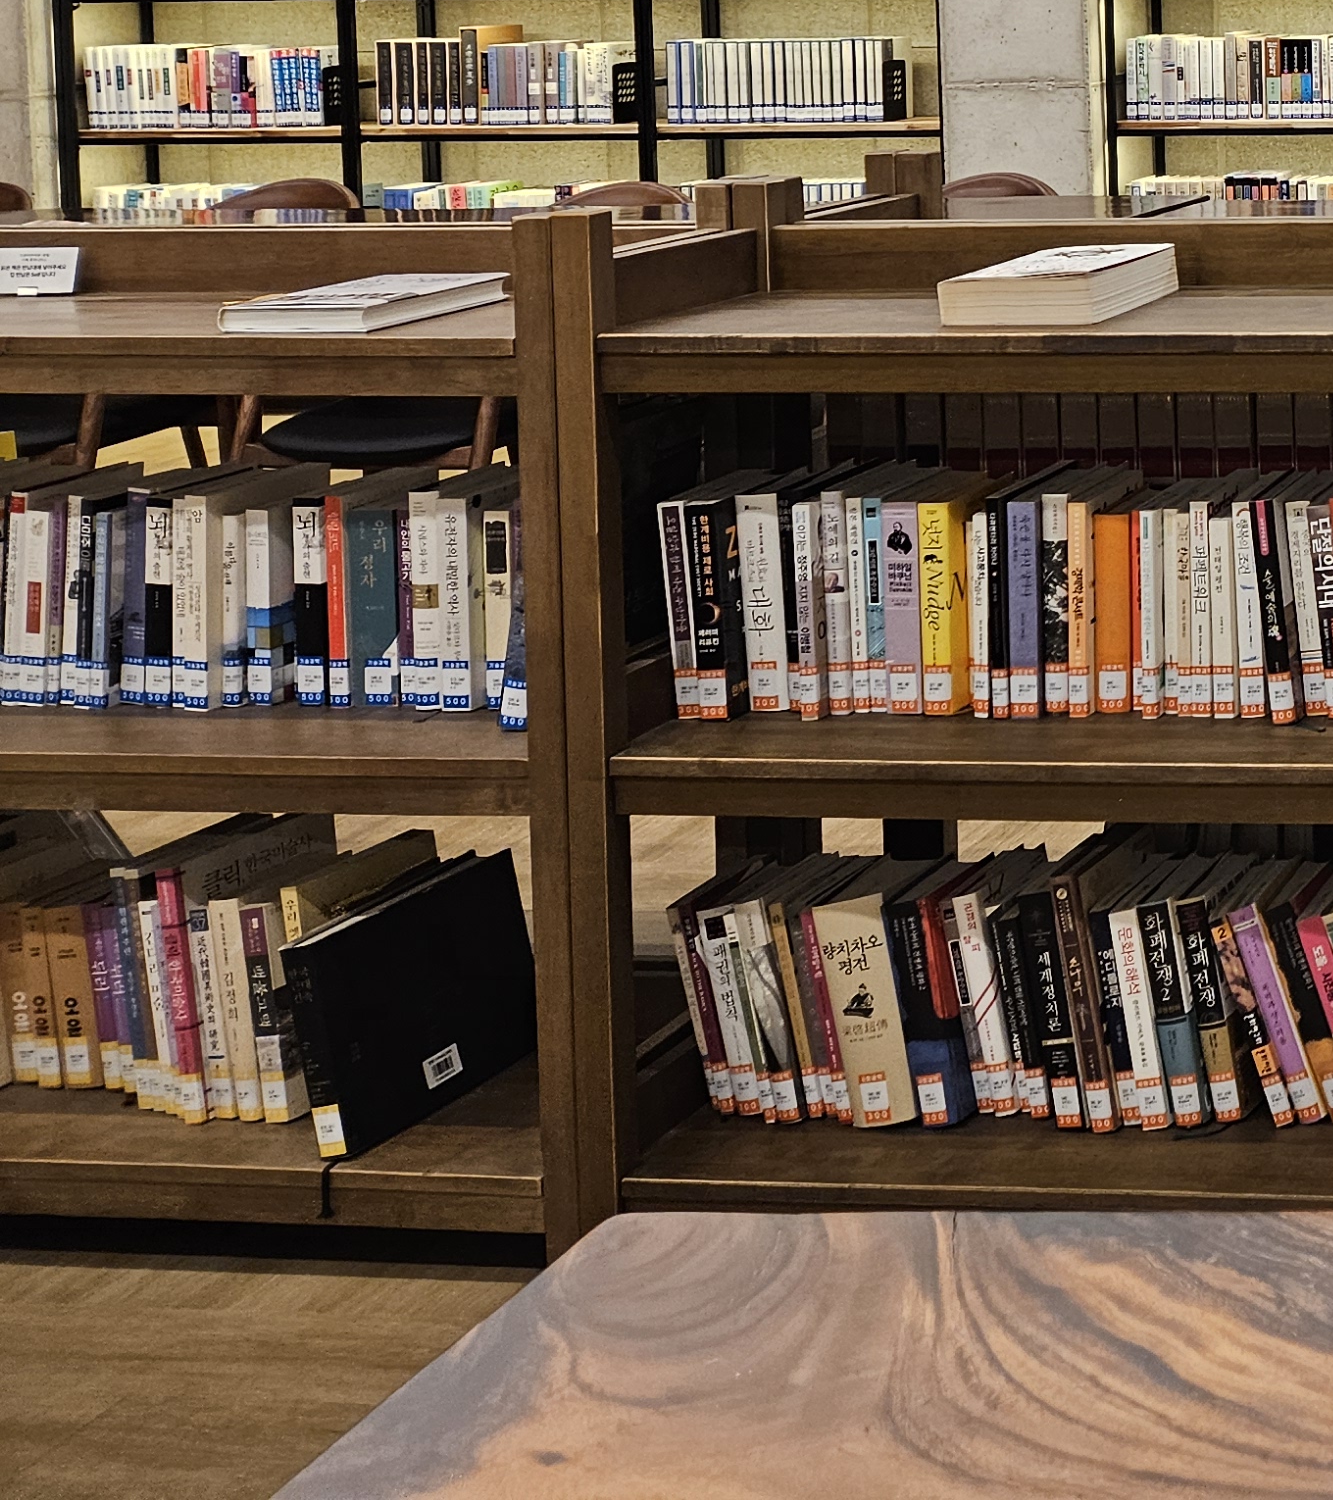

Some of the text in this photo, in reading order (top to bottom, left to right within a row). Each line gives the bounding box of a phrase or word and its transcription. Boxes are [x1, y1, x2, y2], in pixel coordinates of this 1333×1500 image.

[192, 510, 202, 523] 암
[372, 520, 387, 553] 우리
[921, 518, 942, 550] 넛지
[1236, 519, 1251, 575] 행복의 조건
[359, 554, 377, 588] 정자
[797, 555, 808, 581] 정주영
[1192, 546, 1207, 614] 퍼펙트워크
[924, 564, 945, 631] Nudge
[122, 692, 141, 701] 500
[250, 693, 269, 701] 500
[446, 696, 466, 704] 500
[755, 699, 777, 707] 300
[1101, 700, 1123, 708] 300
[823, 935, 884, 961] 량치차오
[1218, 928, 1226, 938] 2
[839, 957, 870, 976] 평전
[1118, 927, 1141, 996] 문화의 해석
[1143, 912, 1173, 1001] 화폐전쟁 2
[1188, 932, 1216, 1007] 화폐전쟁
[224, 972, 240, 1022] 김정희
[713, 944, 739, 1021] 패권의 법칙
[1037, 951, 1061, 1032] 세계정치론
[924, 1113, 944, 1122] 300
